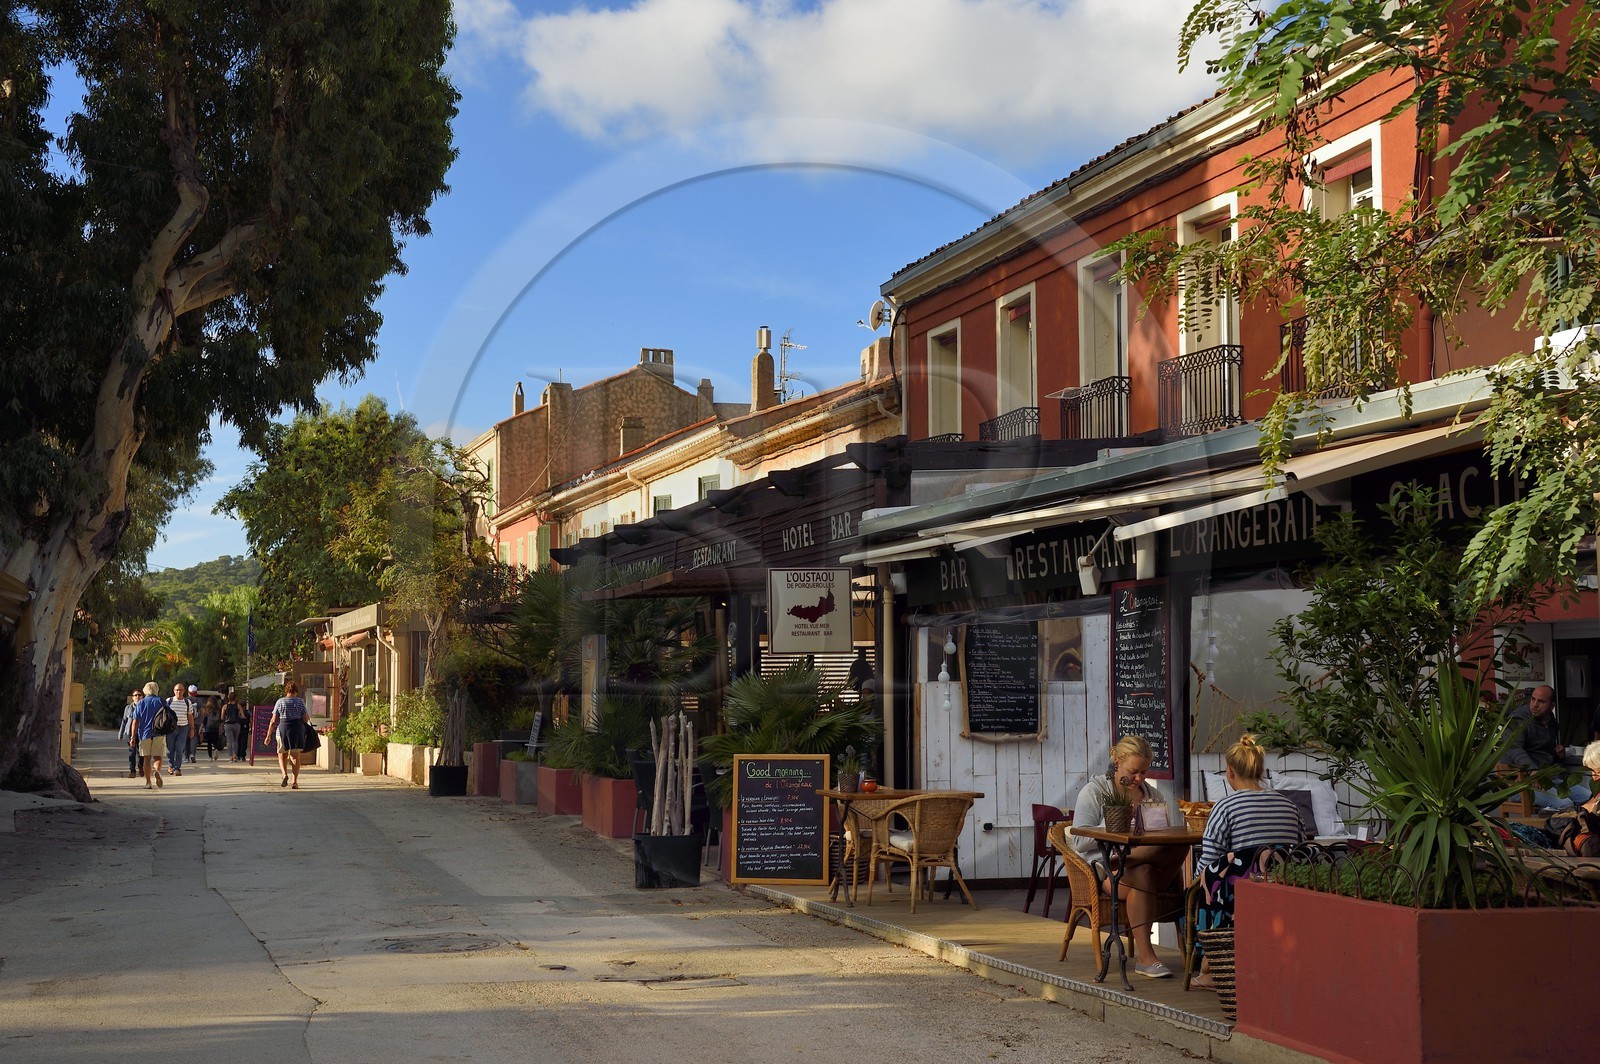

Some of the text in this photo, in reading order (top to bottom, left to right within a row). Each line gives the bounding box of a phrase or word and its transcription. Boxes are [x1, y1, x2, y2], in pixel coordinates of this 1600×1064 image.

[1388, 456, 1526, 525] GLACIE
[782, 511, 852, 552] HOTEL BAR
[693, 541, 738, 567] RESTAURANT
[786, 571, 835, 583] L'OUSTAOU
[940, 556, 967, 591] BAR
[746, 761, 771, 777] Good
[765, 781, 773, 789] de
